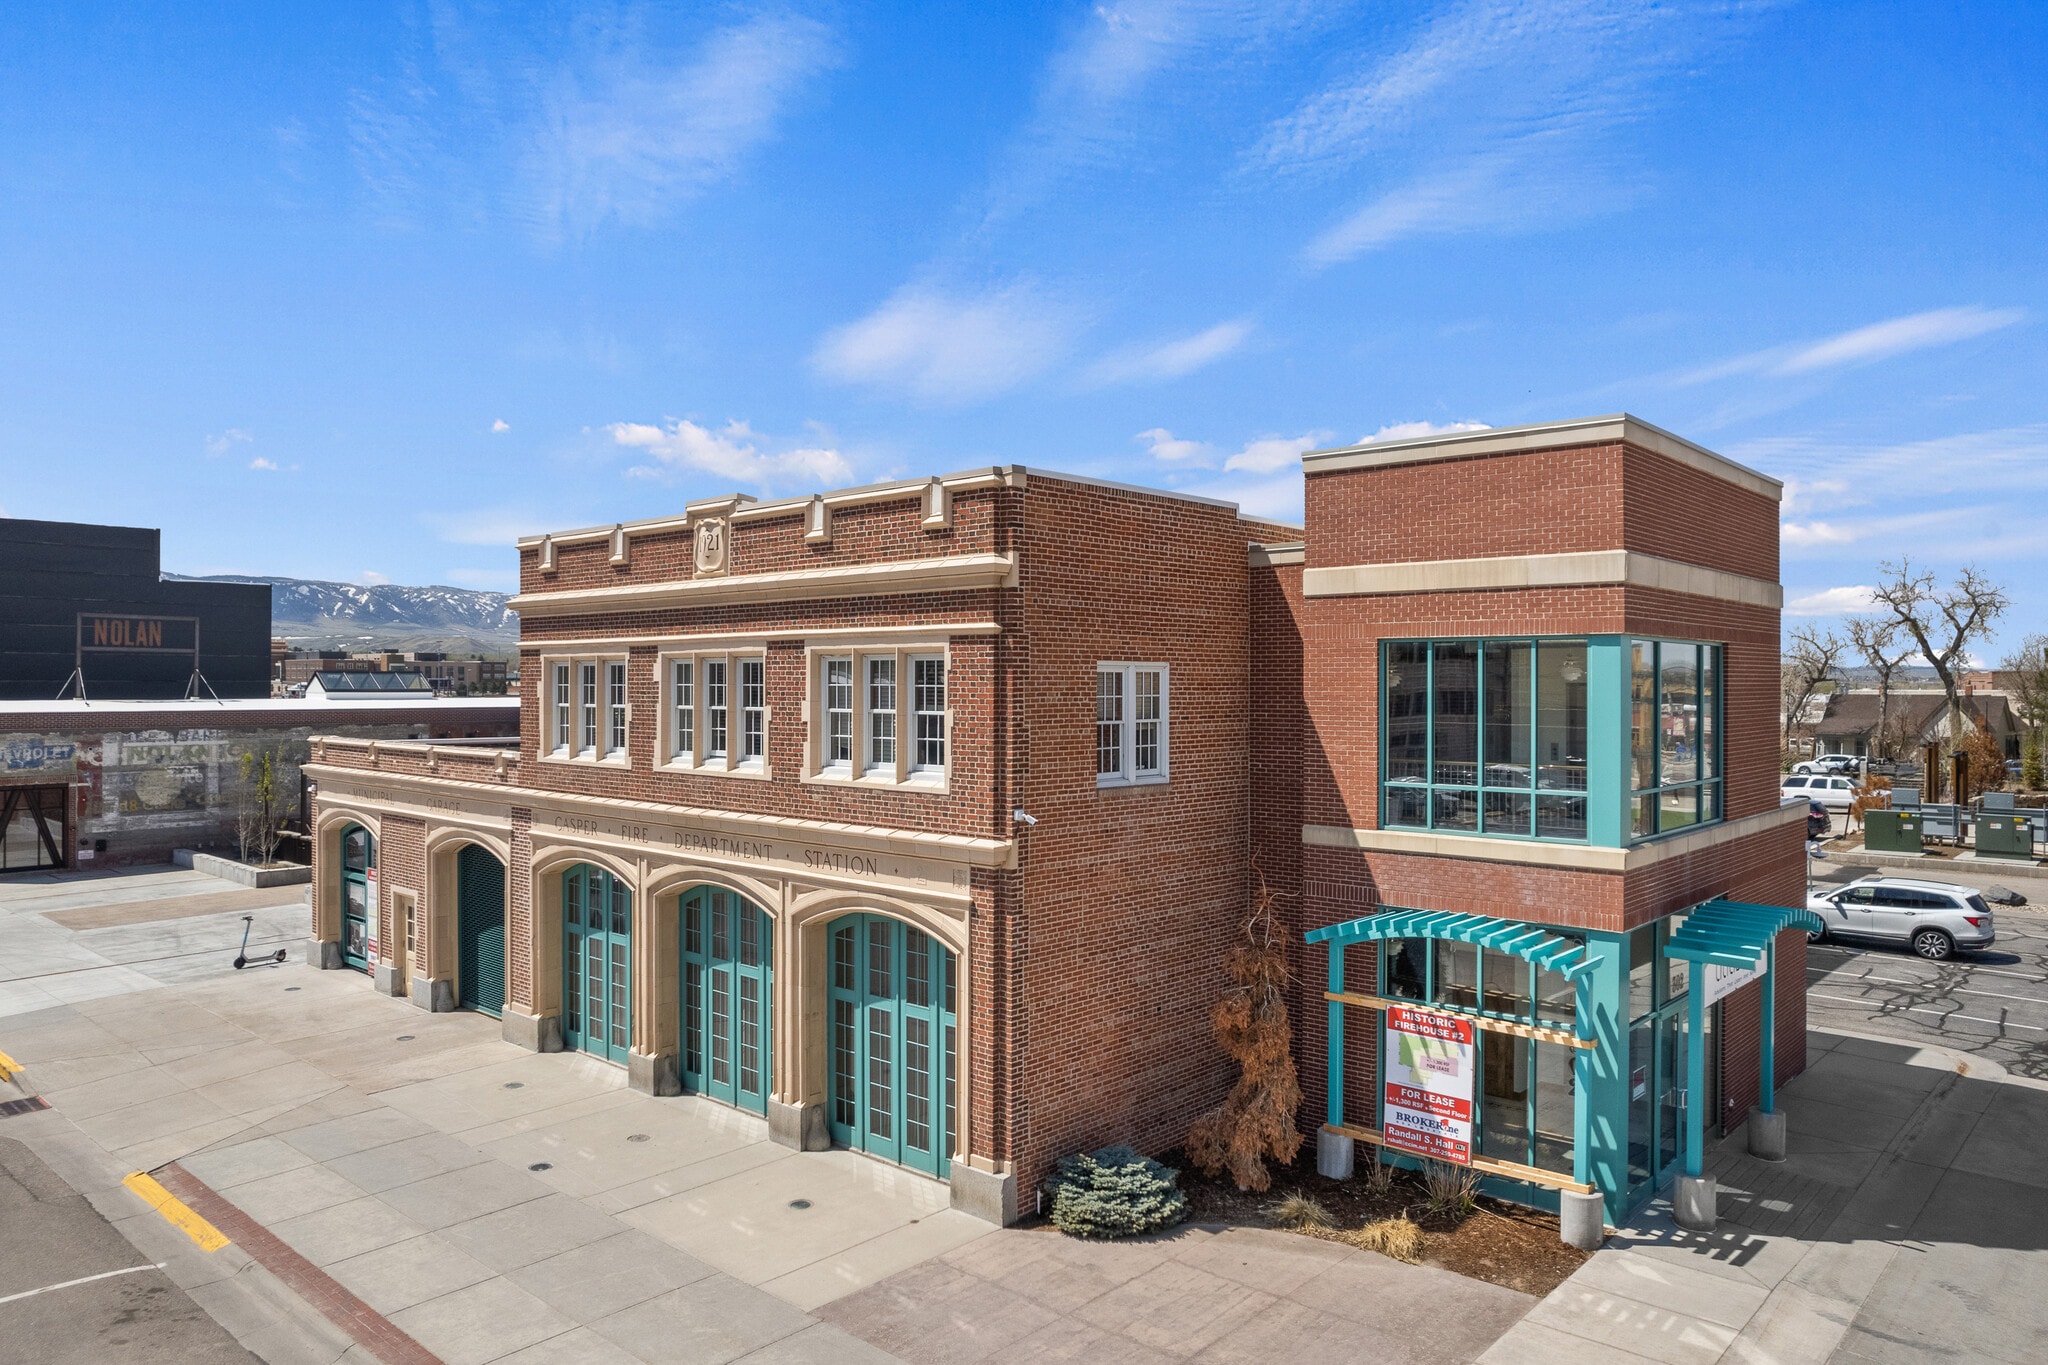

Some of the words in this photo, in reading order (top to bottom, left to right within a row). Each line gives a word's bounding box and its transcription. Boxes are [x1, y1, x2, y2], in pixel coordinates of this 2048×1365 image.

[94, 618, 162, 647] NOLAN
[352, 787, 395, 806] MUNICIPAL
[426, 798, 462, 816] GARAGE
[554, 815, 598, 836] CASPER
[621, 824, 649, 844] FIRE
[674, 832, 773, 862] DEPARTMENT
[804, 849, 877, 877] STATION
[1394, 1020, 1450, 1038] FIREHOUSE
[1451, 1031, 1465, 1041] #2
[1402, 1011, 1456, 1029] HISTORIC
[1401, 1088, 1421, 1099] FOR
[1423, 1093, 1455, 1108] LEASE
[1429, 1105, 1451, 1116] Second
[1451, 1110, 1468, 1119] Floor
[1388, 1126, 1422, 1142] Randall
[1424, 1135, 1433, 1145] S.
[1435, 1138, 1454, 1150] Hall
